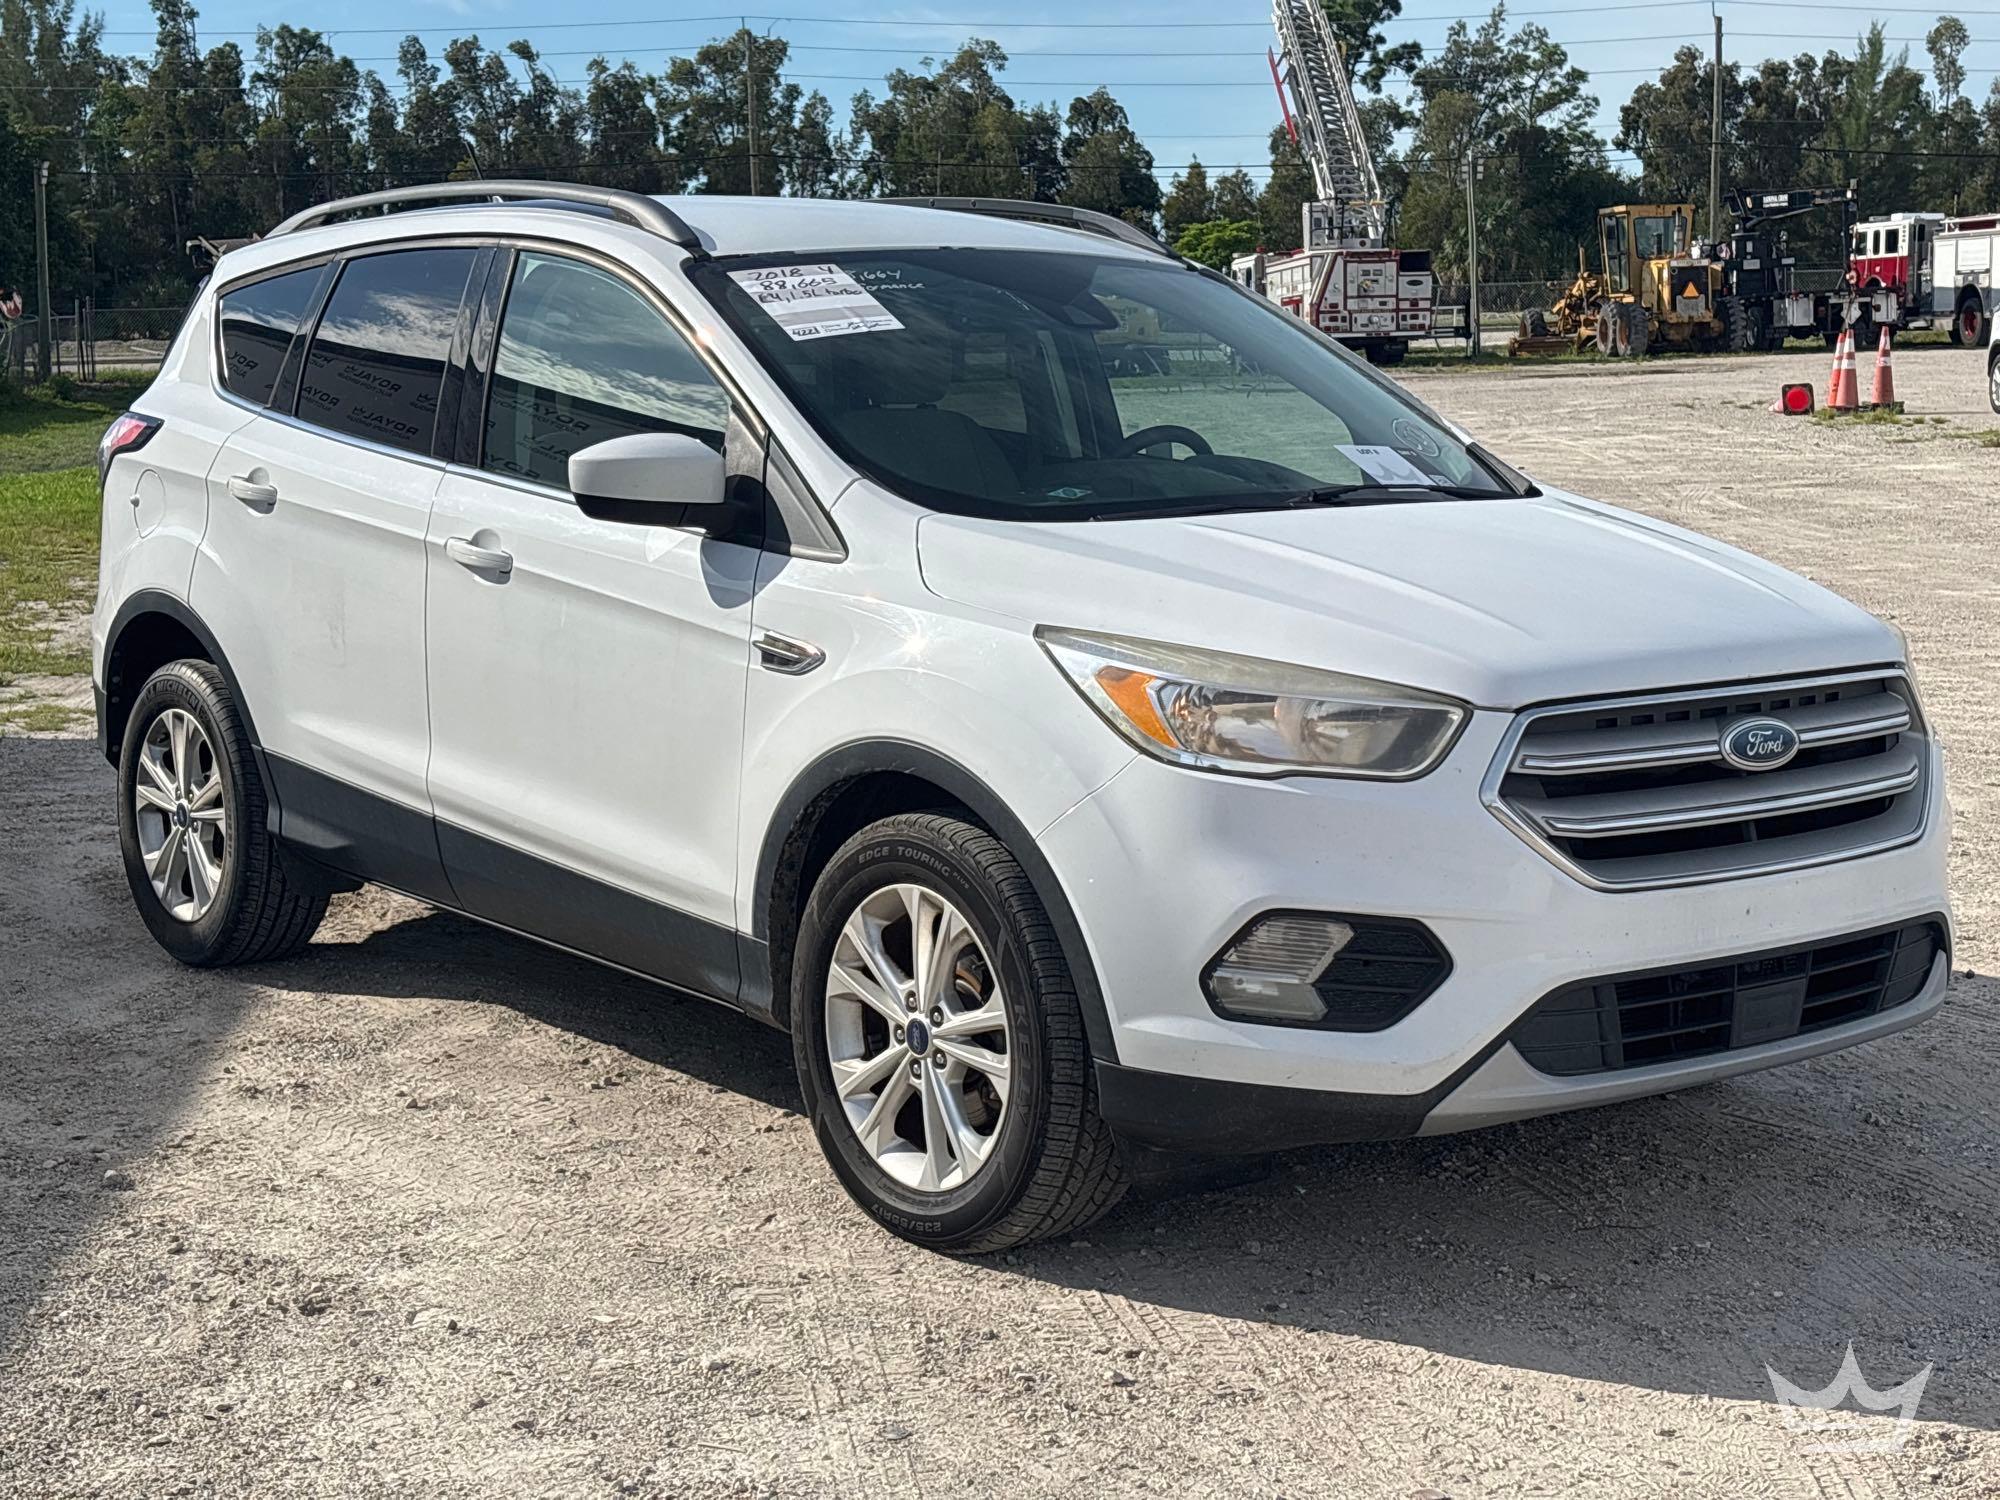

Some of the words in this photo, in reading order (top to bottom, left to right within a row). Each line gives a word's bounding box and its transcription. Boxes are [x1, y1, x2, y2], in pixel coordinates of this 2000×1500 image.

[748, 268, 803, 280] 2018
[760, 278, 837, 291] 88,665
[1746, 730, 1784, 756] Ford
[858, 846, 890, 864] EDGE
[897, 846, 951, 877] TOURING
